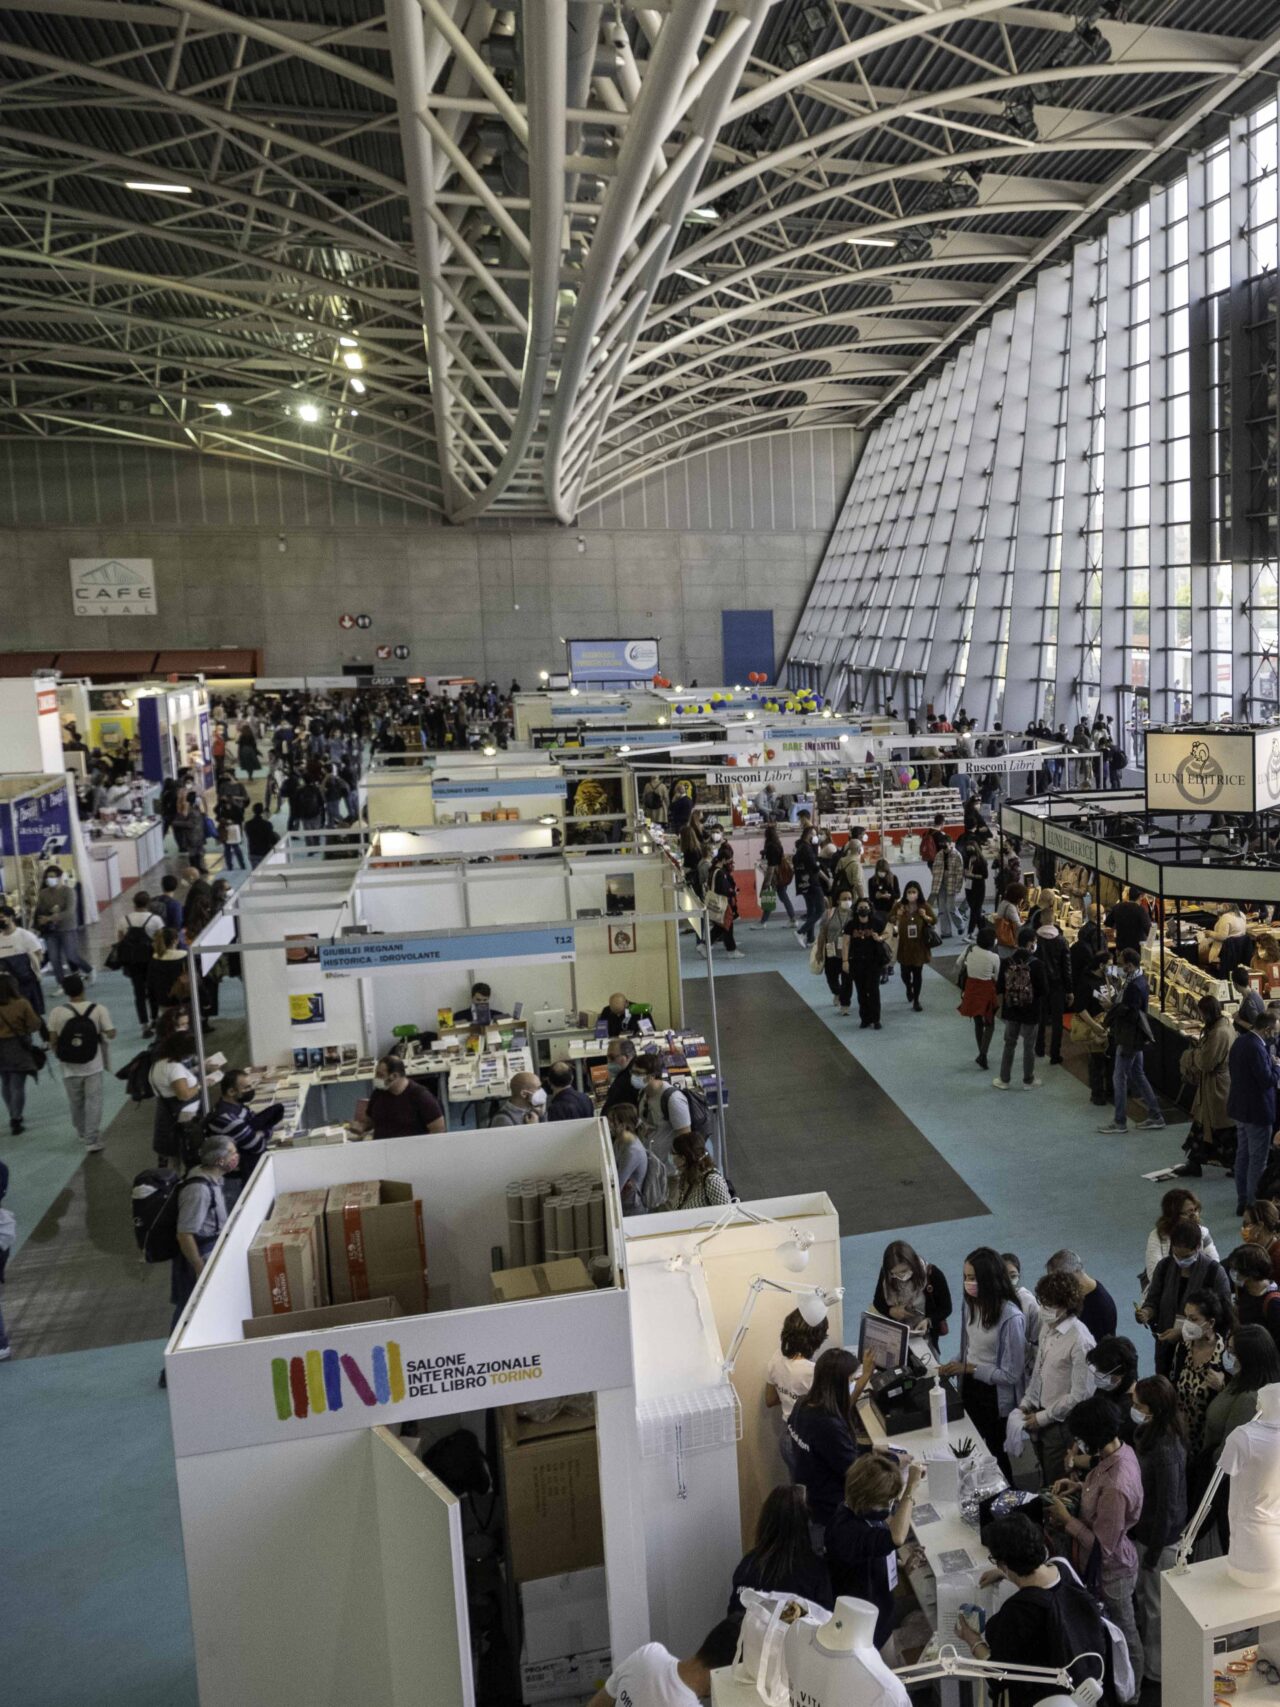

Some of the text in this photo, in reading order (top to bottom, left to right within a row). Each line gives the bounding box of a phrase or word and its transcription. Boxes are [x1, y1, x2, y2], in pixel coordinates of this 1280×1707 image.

[965, 760, 1036, 772] Rusconi Libri
[715, 770, 793, 784] Rusconi Libri
[1155, 773, 1246, 786] LUNI EDITRICE
[1047, 830, 1095, 861] LUNI EDITRICE
[554, 935, 573, 945] T12
[322, 943, 404, 957] GIUBILEI REGNANI
[323, 956, 372, 967] HISTORICA
[379, 951, 441, 963] IDROVOLANTE
[406, 1353, 467, 1373] SALONE
[407, 1354, 542, 1386] INTERNAZIONALE
[408, 1367, 543, 1398] DEL LIBRO TORINO
